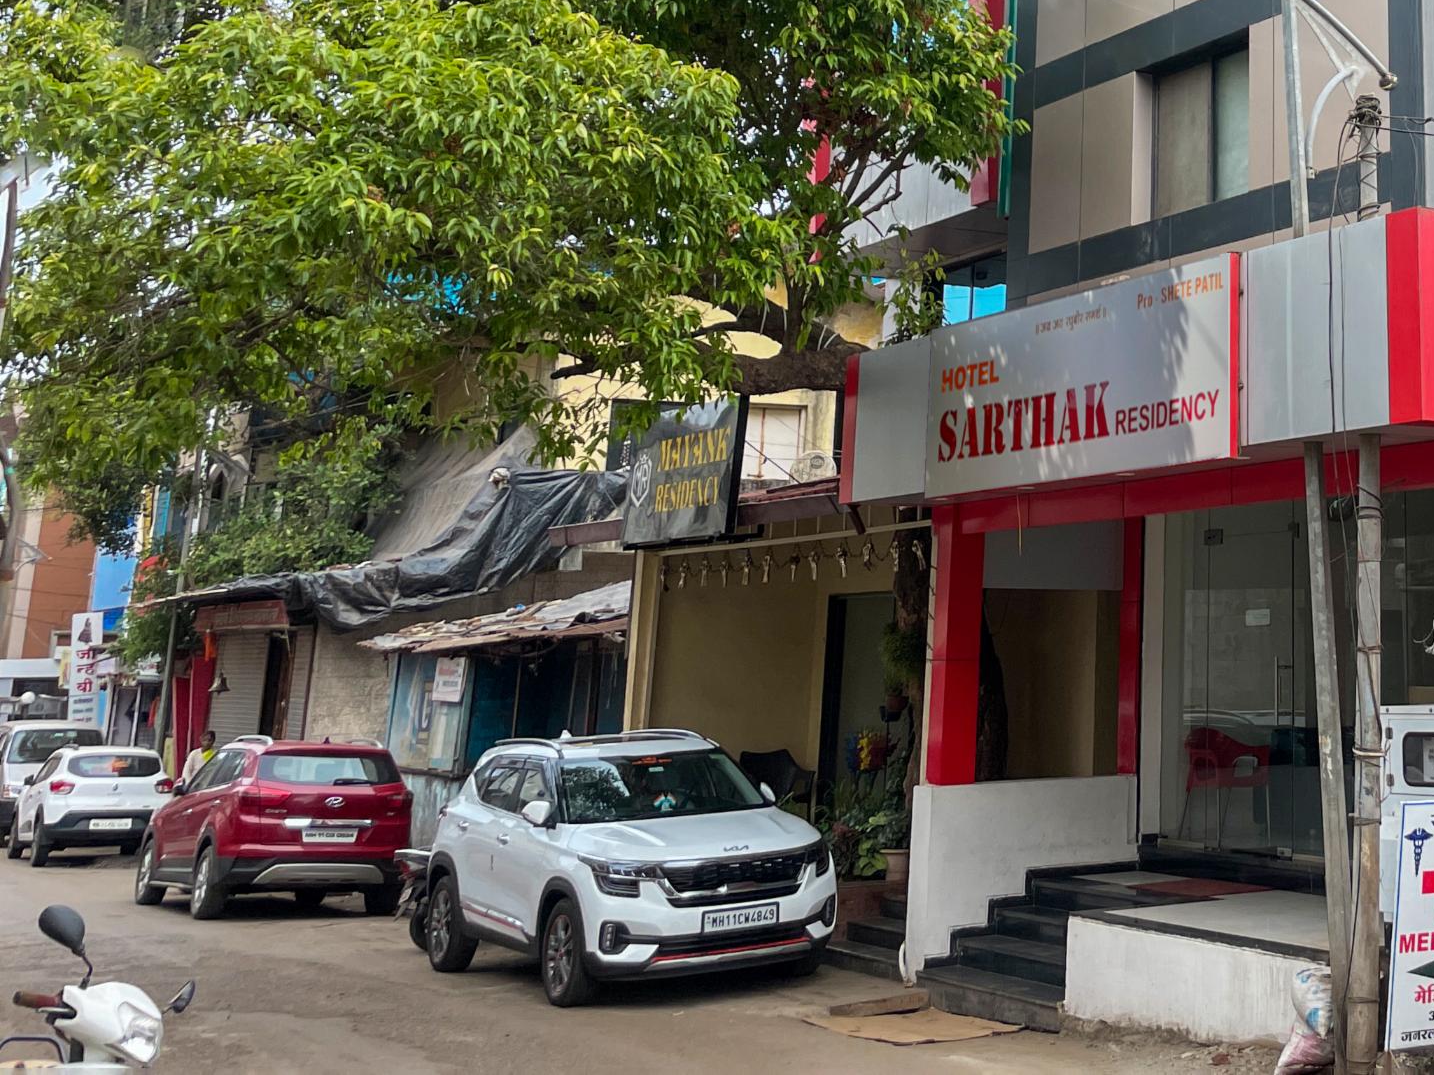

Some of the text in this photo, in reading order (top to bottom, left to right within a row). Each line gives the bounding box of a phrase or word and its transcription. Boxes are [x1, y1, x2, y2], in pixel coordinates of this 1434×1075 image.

[1136, 292, 1153, 310] Pro
[1160, 281, 1192, 304] SHETE
[1194, 271, 1224, 294] PATIL
[941, 360, 1000, 393] HOTEL
[937, 381, 1220, 463] SARTHAK RESIDENCY
[657, 427, 731, 472] MAYANK
[655, 476, 721, 513] RESIDENCY
[711, 907, 775, 928] MH11CW4849
